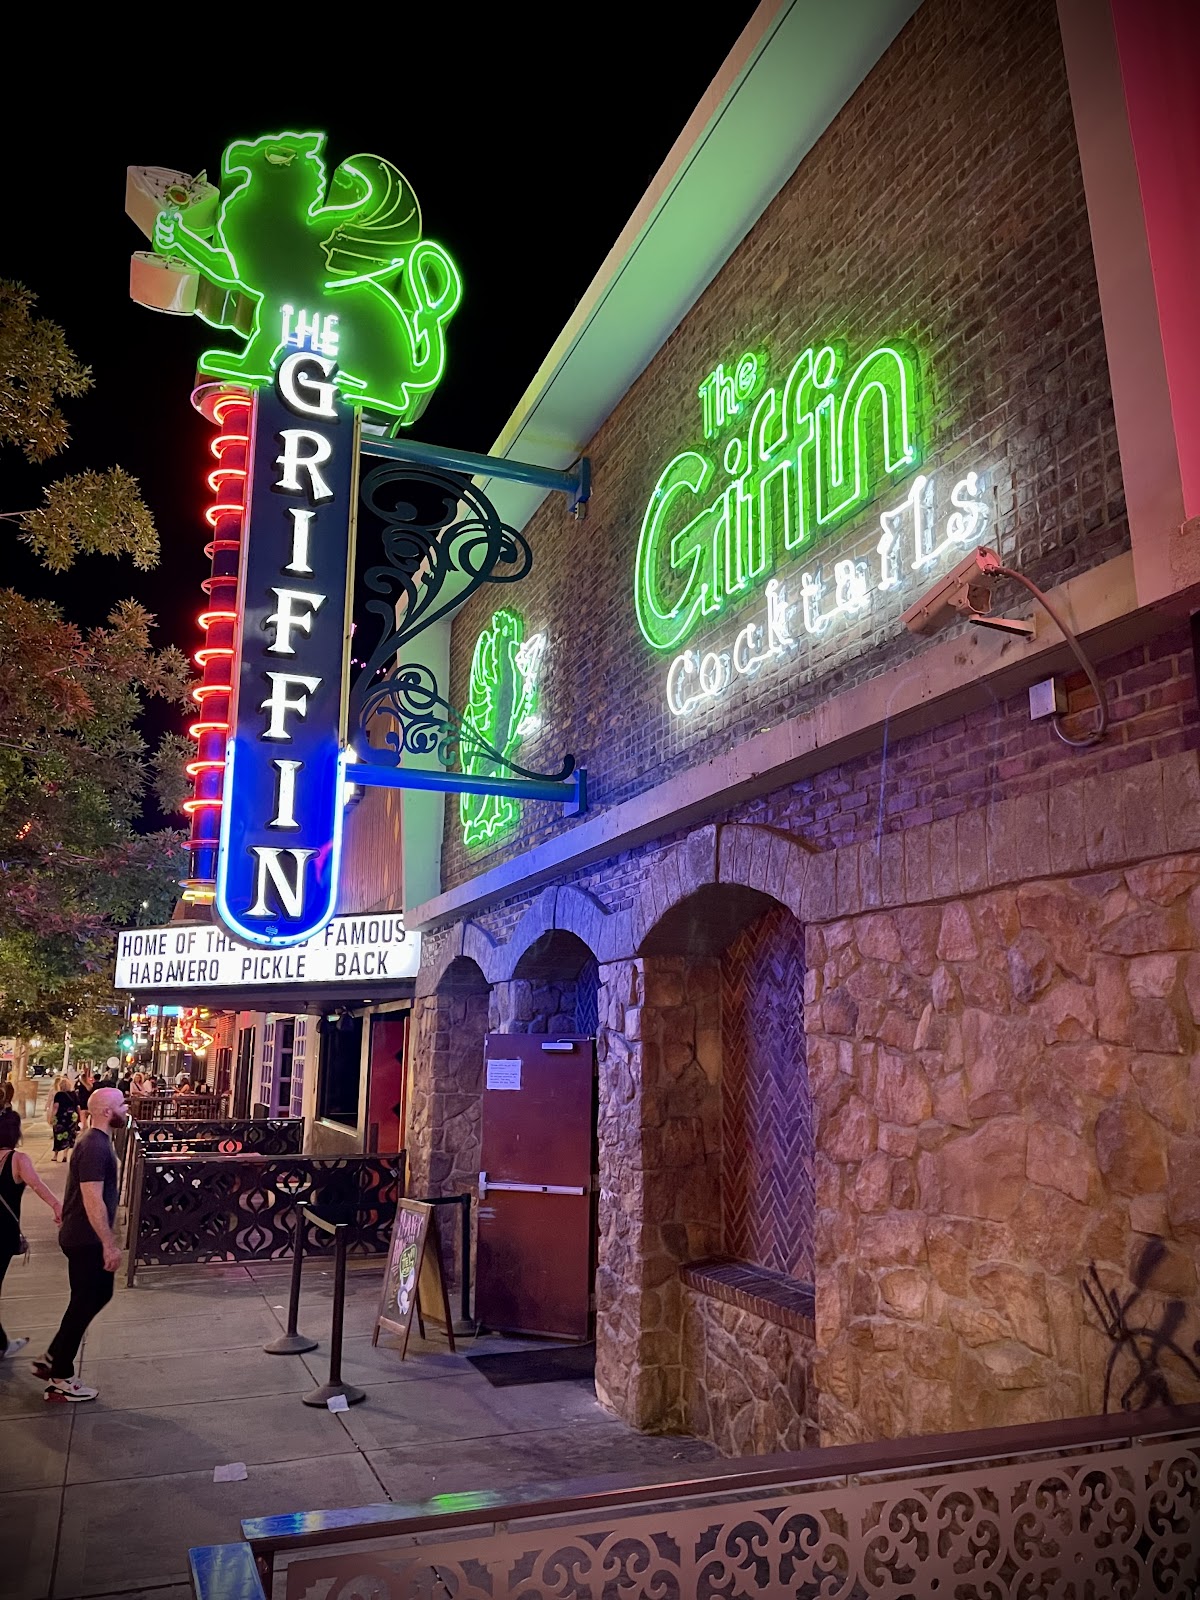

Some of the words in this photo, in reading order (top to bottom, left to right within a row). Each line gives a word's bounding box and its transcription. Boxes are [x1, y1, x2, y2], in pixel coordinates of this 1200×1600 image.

[280, 303, 340, 357] THE
[698, 351, 759, 440] The
[634, 345, 915, 650] Griffin
[241, 351, 340, 918] GRIFFIN
[121, 932, 168, 958] HOME
[175, 932, 197, 955] OF
[206, 930, 237, 954] THE
[323, 919, 407, 947] FAMOUS
[129, 959, 220, 984] HABANERO
[240, 954, 306, 981] PICKLE
[334, 950, 389, 977] BACK
